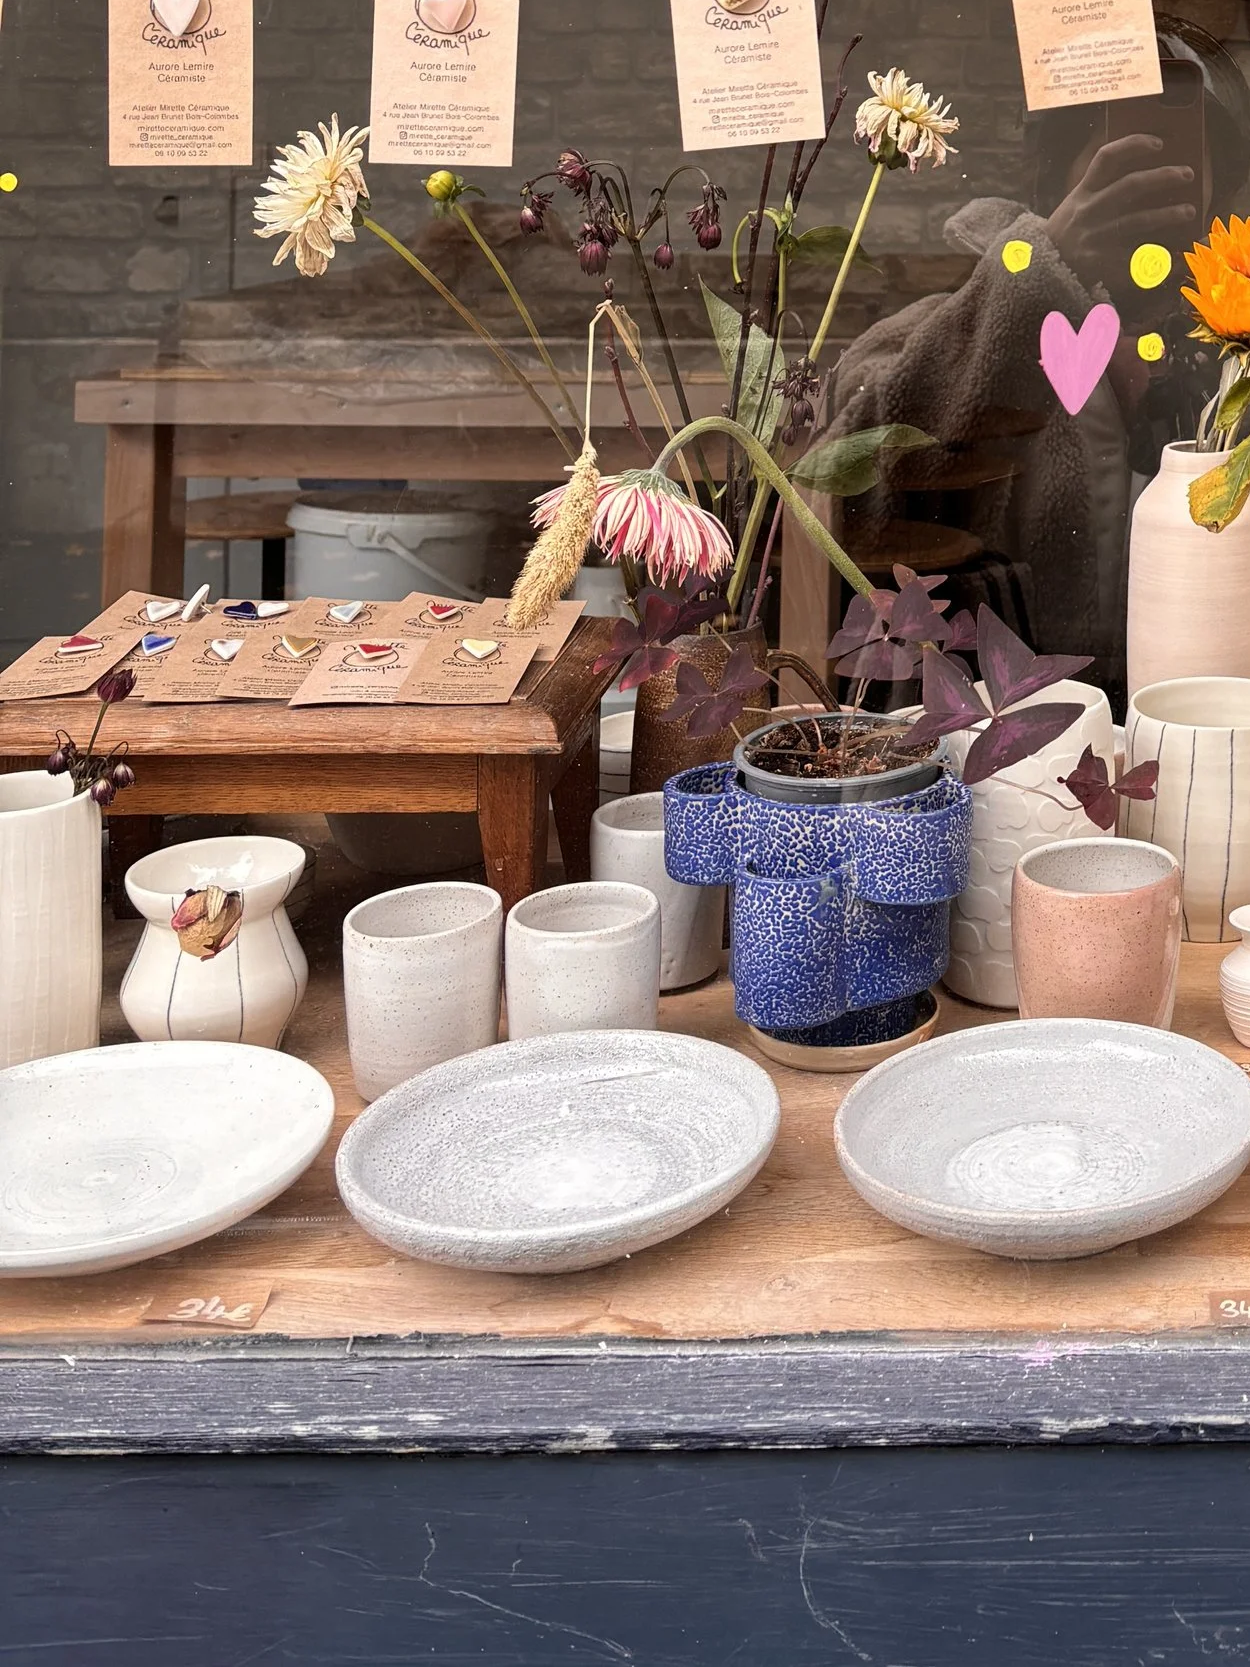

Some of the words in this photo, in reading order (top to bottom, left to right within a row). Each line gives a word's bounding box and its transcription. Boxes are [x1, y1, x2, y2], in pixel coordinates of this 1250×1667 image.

[148, 61, 179, 70] Aurore
[182, 61, 214, 70] Lemire
[410, 60, 441, 70] Aurore
[444, 61, 477, 71] Lemire
[157, 72, 205, 82] Céramiste
[418, 71, 467, 82] Céramiste
[167, 1295, 254, 1322] 34€
